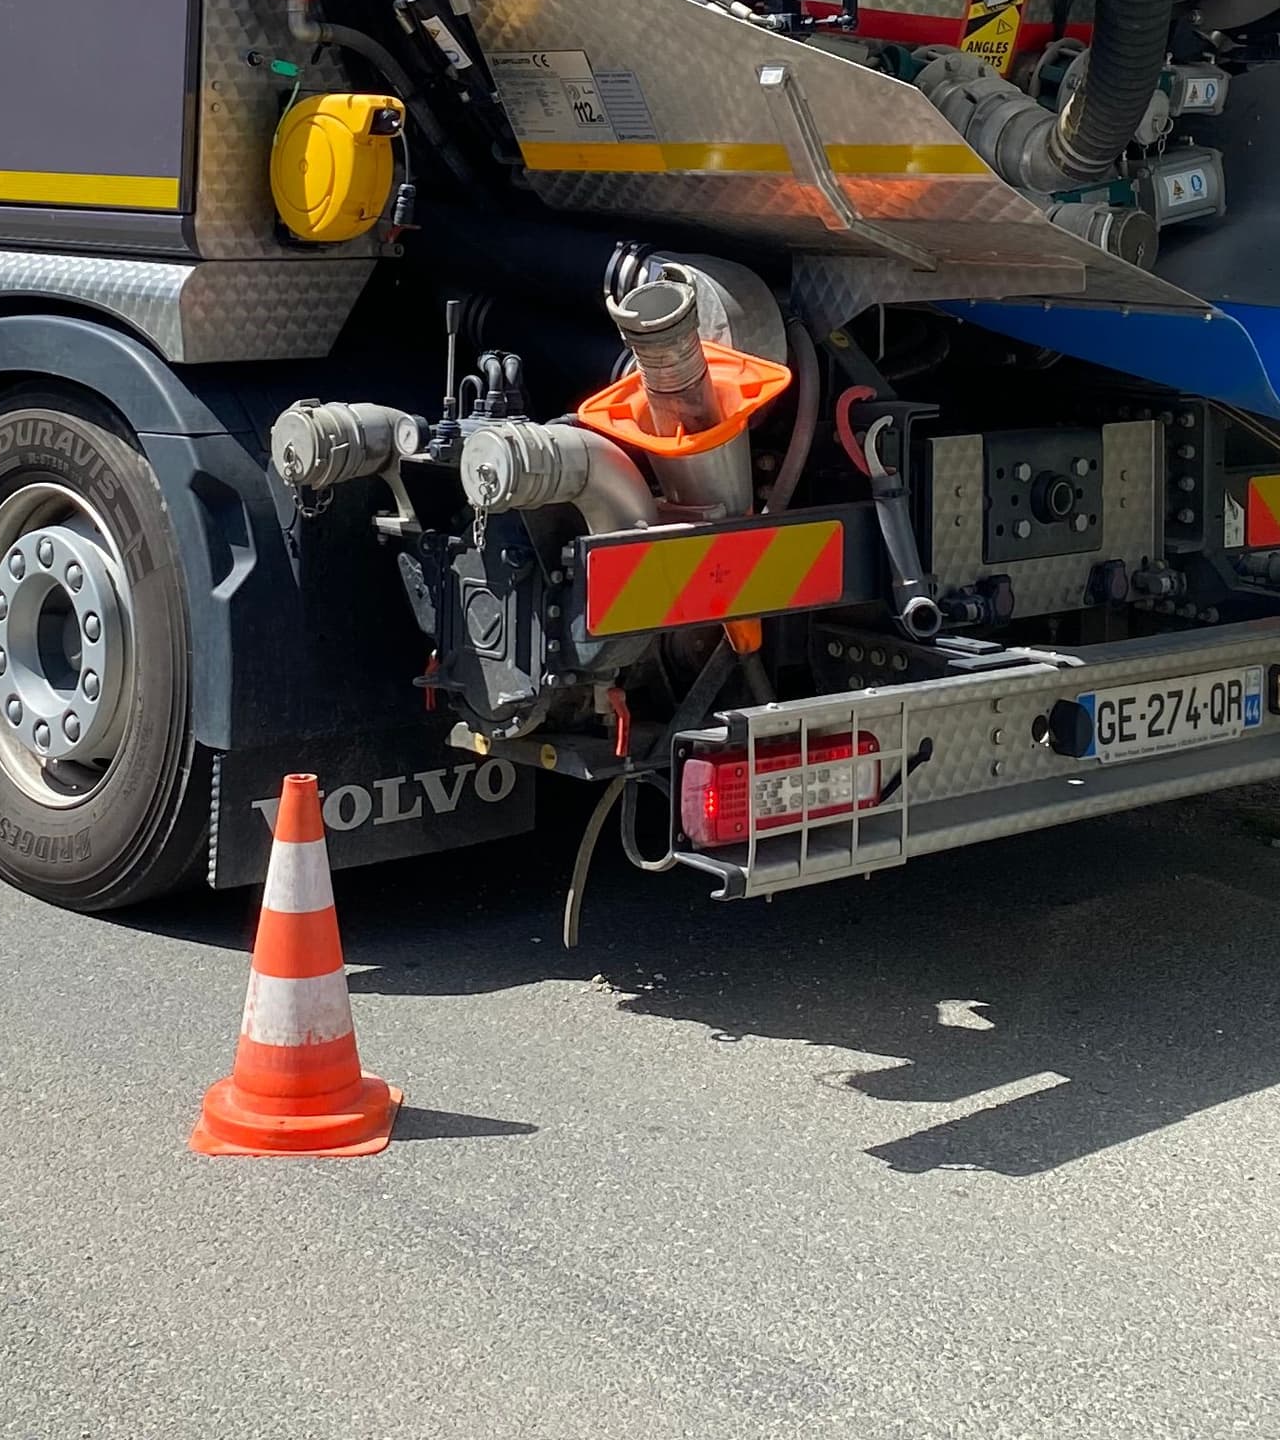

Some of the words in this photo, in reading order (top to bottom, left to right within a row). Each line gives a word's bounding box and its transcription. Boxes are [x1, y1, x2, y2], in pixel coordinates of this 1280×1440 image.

[966, 40, 1009, 54] ANGLES
[574, 102, 596, 122] 112
[1097, 679, 1243, 746] GE-274-QR
[1245, 699, 1259, 720] 44
